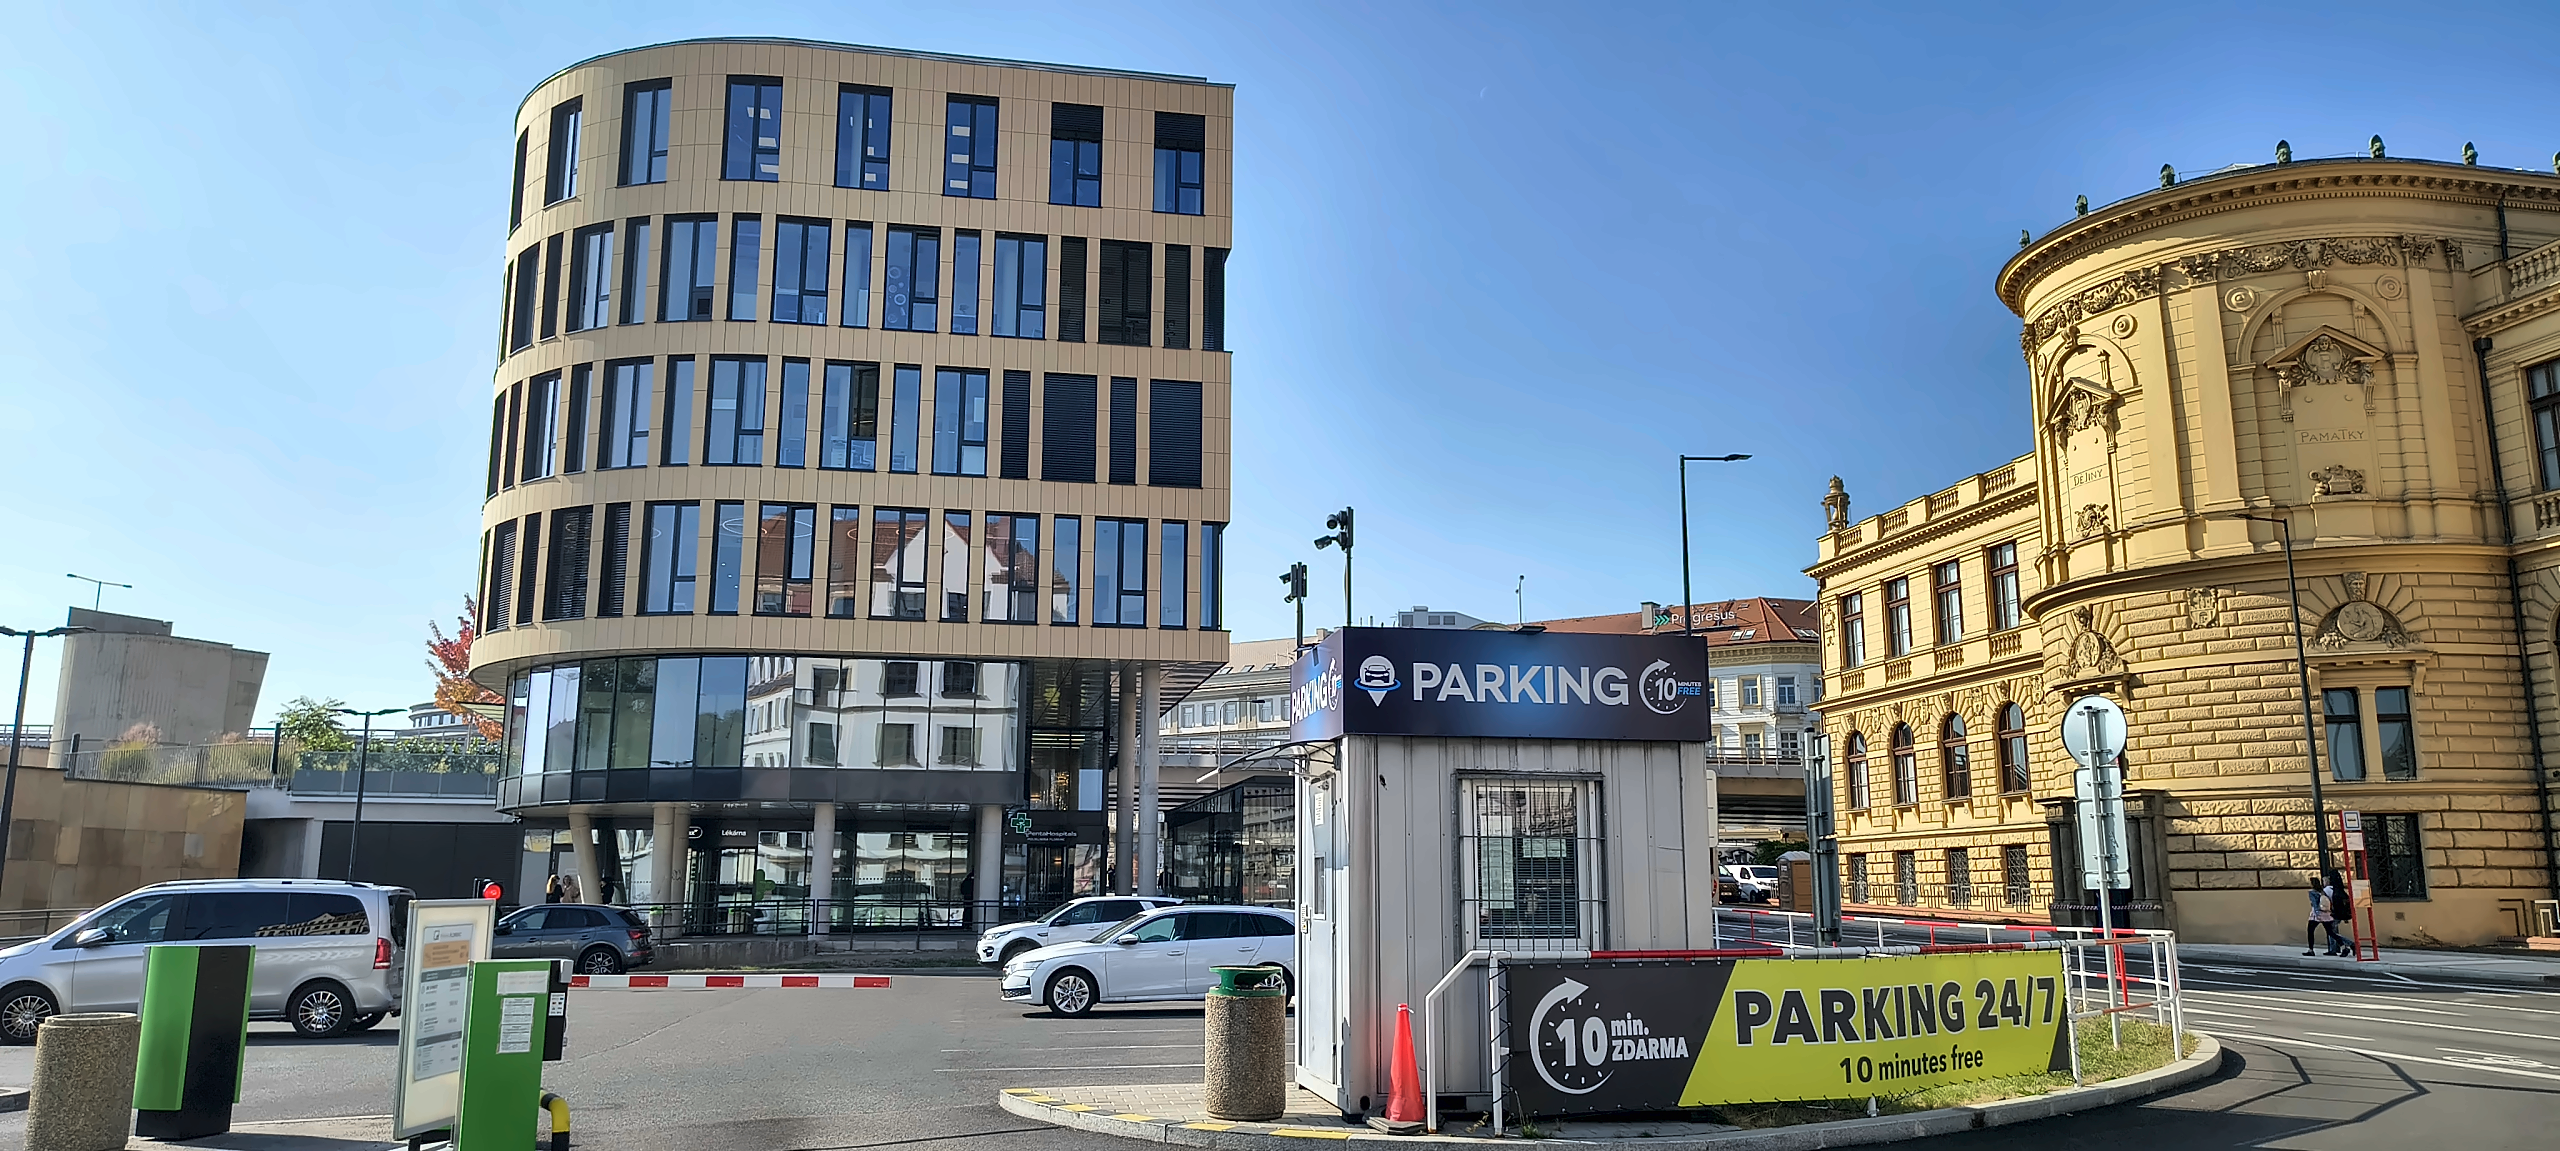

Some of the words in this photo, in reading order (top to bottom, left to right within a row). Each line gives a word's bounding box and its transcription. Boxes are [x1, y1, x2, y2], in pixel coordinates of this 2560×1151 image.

[1671, 611, 1735, 626] Prgresus
[1412, 662, 1629, 706] PARKING
[1655, 677, 1677, 701] 10
[1677, 687, 1701, 696] FREE
[1291, 671, 1328, 725] PARKING
[721, 829, 747, 837] Lékárna
[1733, 980, 1967, 1047] PARKING
[1974, 974, 2056, 1031] 24/7
[1610, 1012, 1650, 1037] min.
[1555, 1016, 1608, 1067] 10
[1611, 1036, 1689, 1062] ZDARMA
[1840, 1056, 1873, 1084] 10
[1878, 1053, 1947, 1081] minutes
[1950, 1044, 1984, 1070] free
